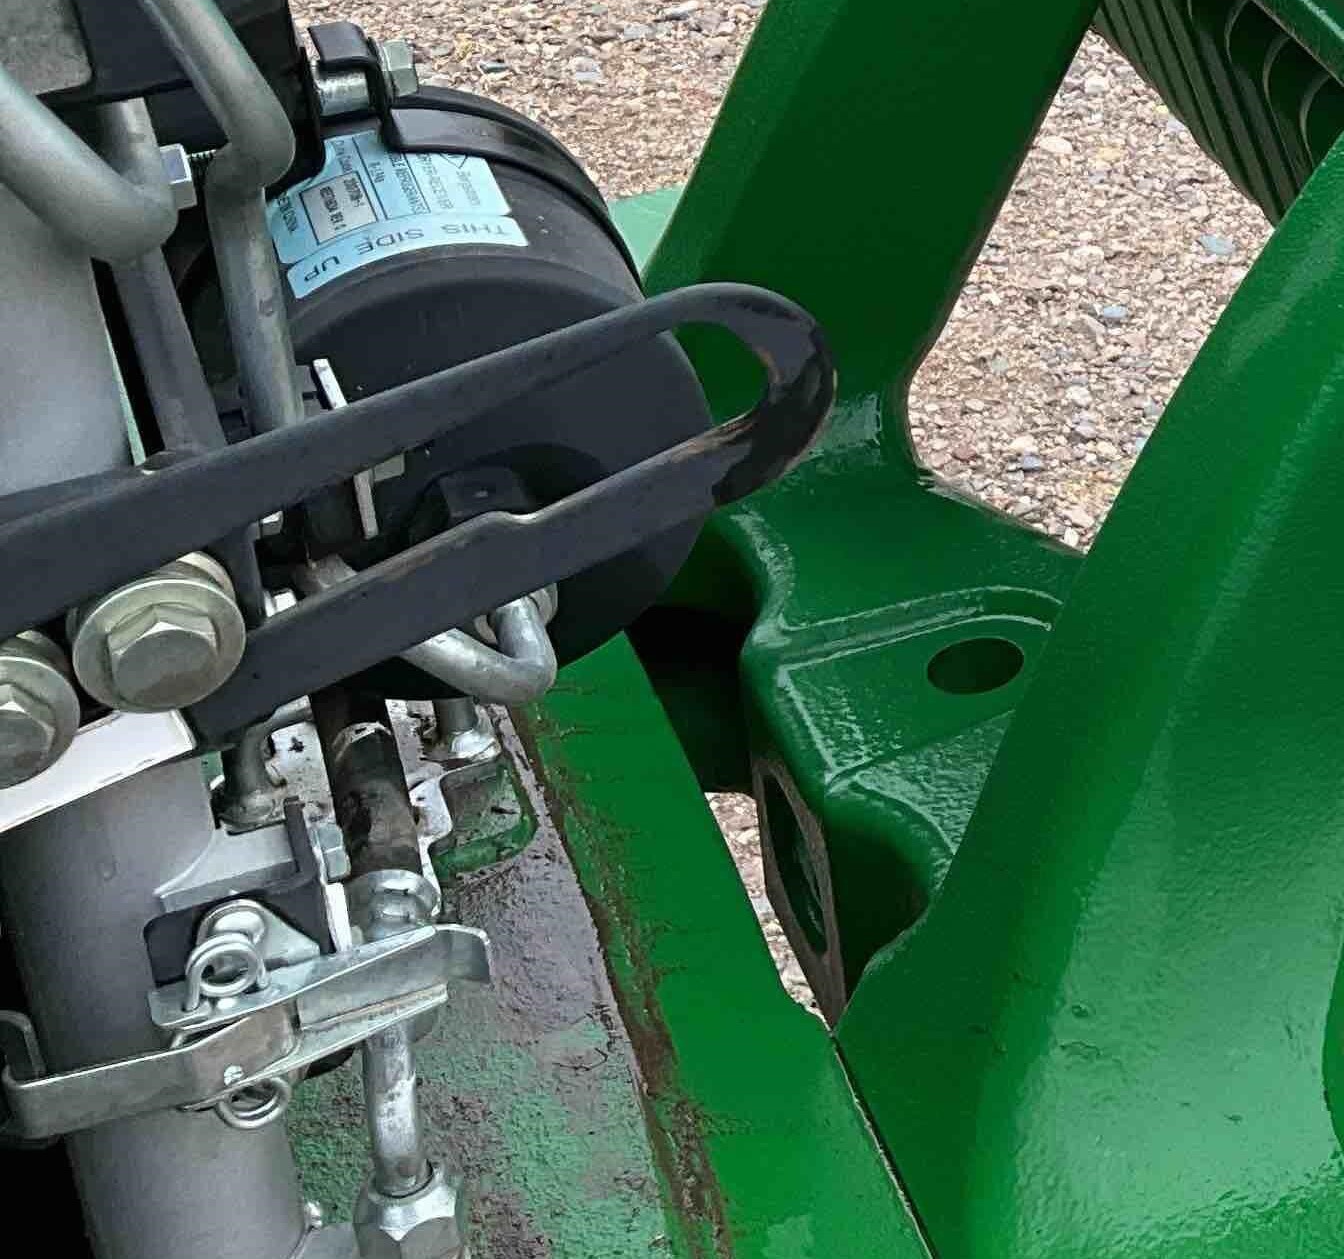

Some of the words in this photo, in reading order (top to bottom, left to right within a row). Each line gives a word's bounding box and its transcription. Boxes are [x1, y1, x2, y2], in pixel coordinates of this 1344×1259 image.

[356, 227, 425, 255] SIDE
[441, 223, 512, 236] THIS
[303, 255, 341, 281] UP
